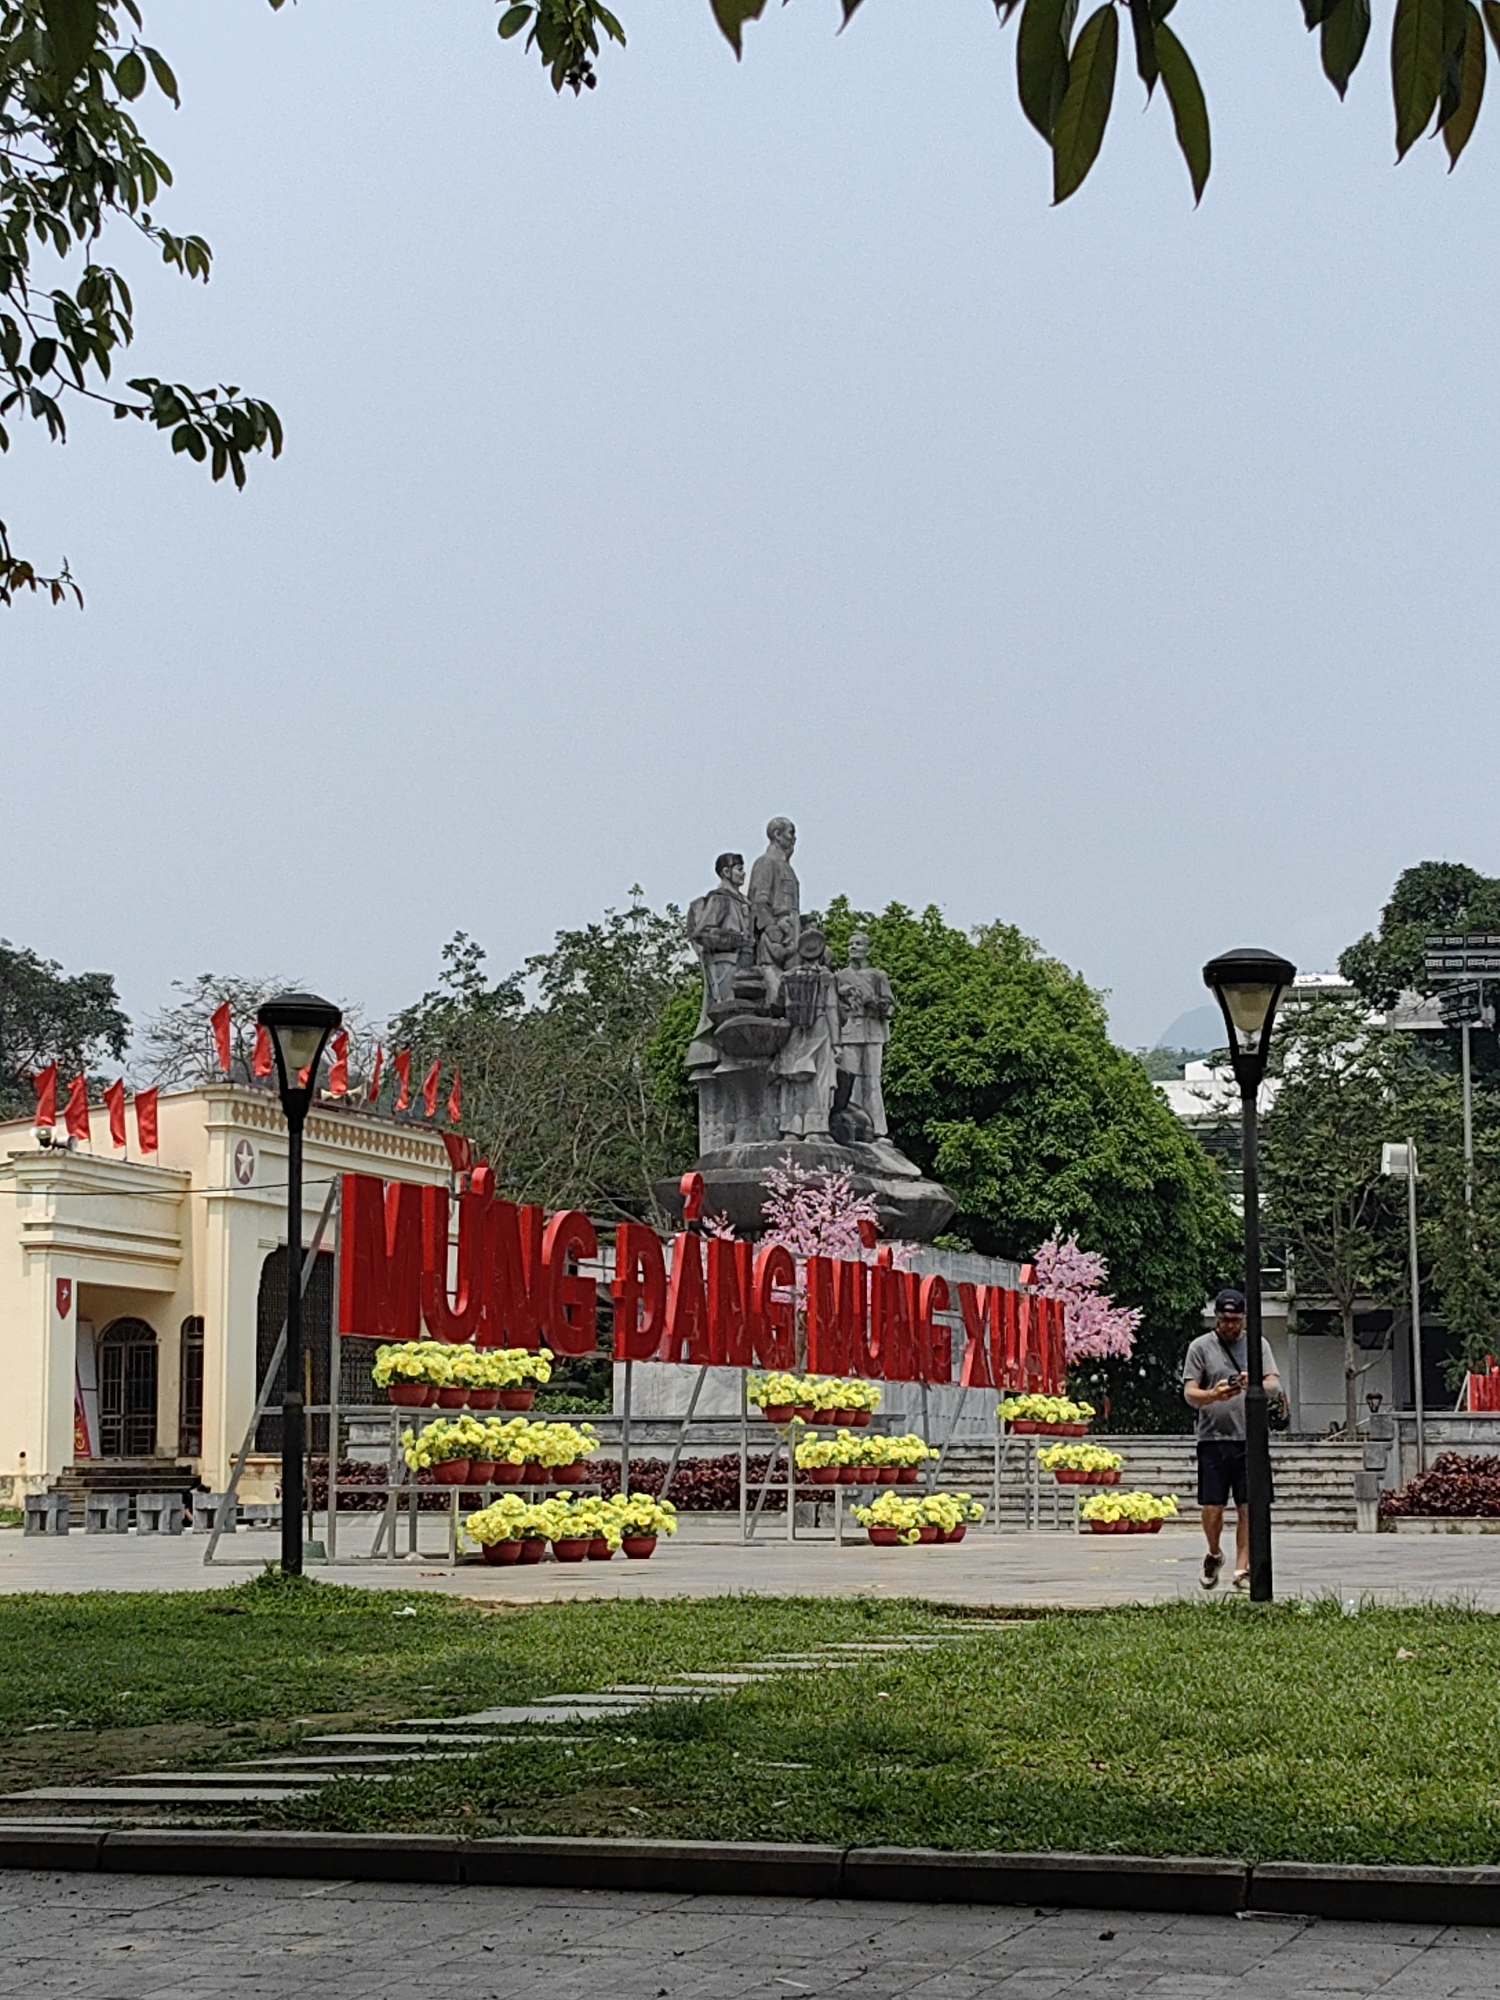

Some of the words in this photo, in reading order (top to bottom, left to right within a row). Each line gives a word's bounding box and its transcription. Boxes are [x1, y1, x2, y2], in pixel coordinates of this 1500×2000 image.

[340, 1132, 598, 1356] MỪNG
[610, 1172, 796, 1371] ĐẢNG
[806, 1219, 952, 1384] MỪNG
[957, 1263, 1067, 1396] XUÂN
